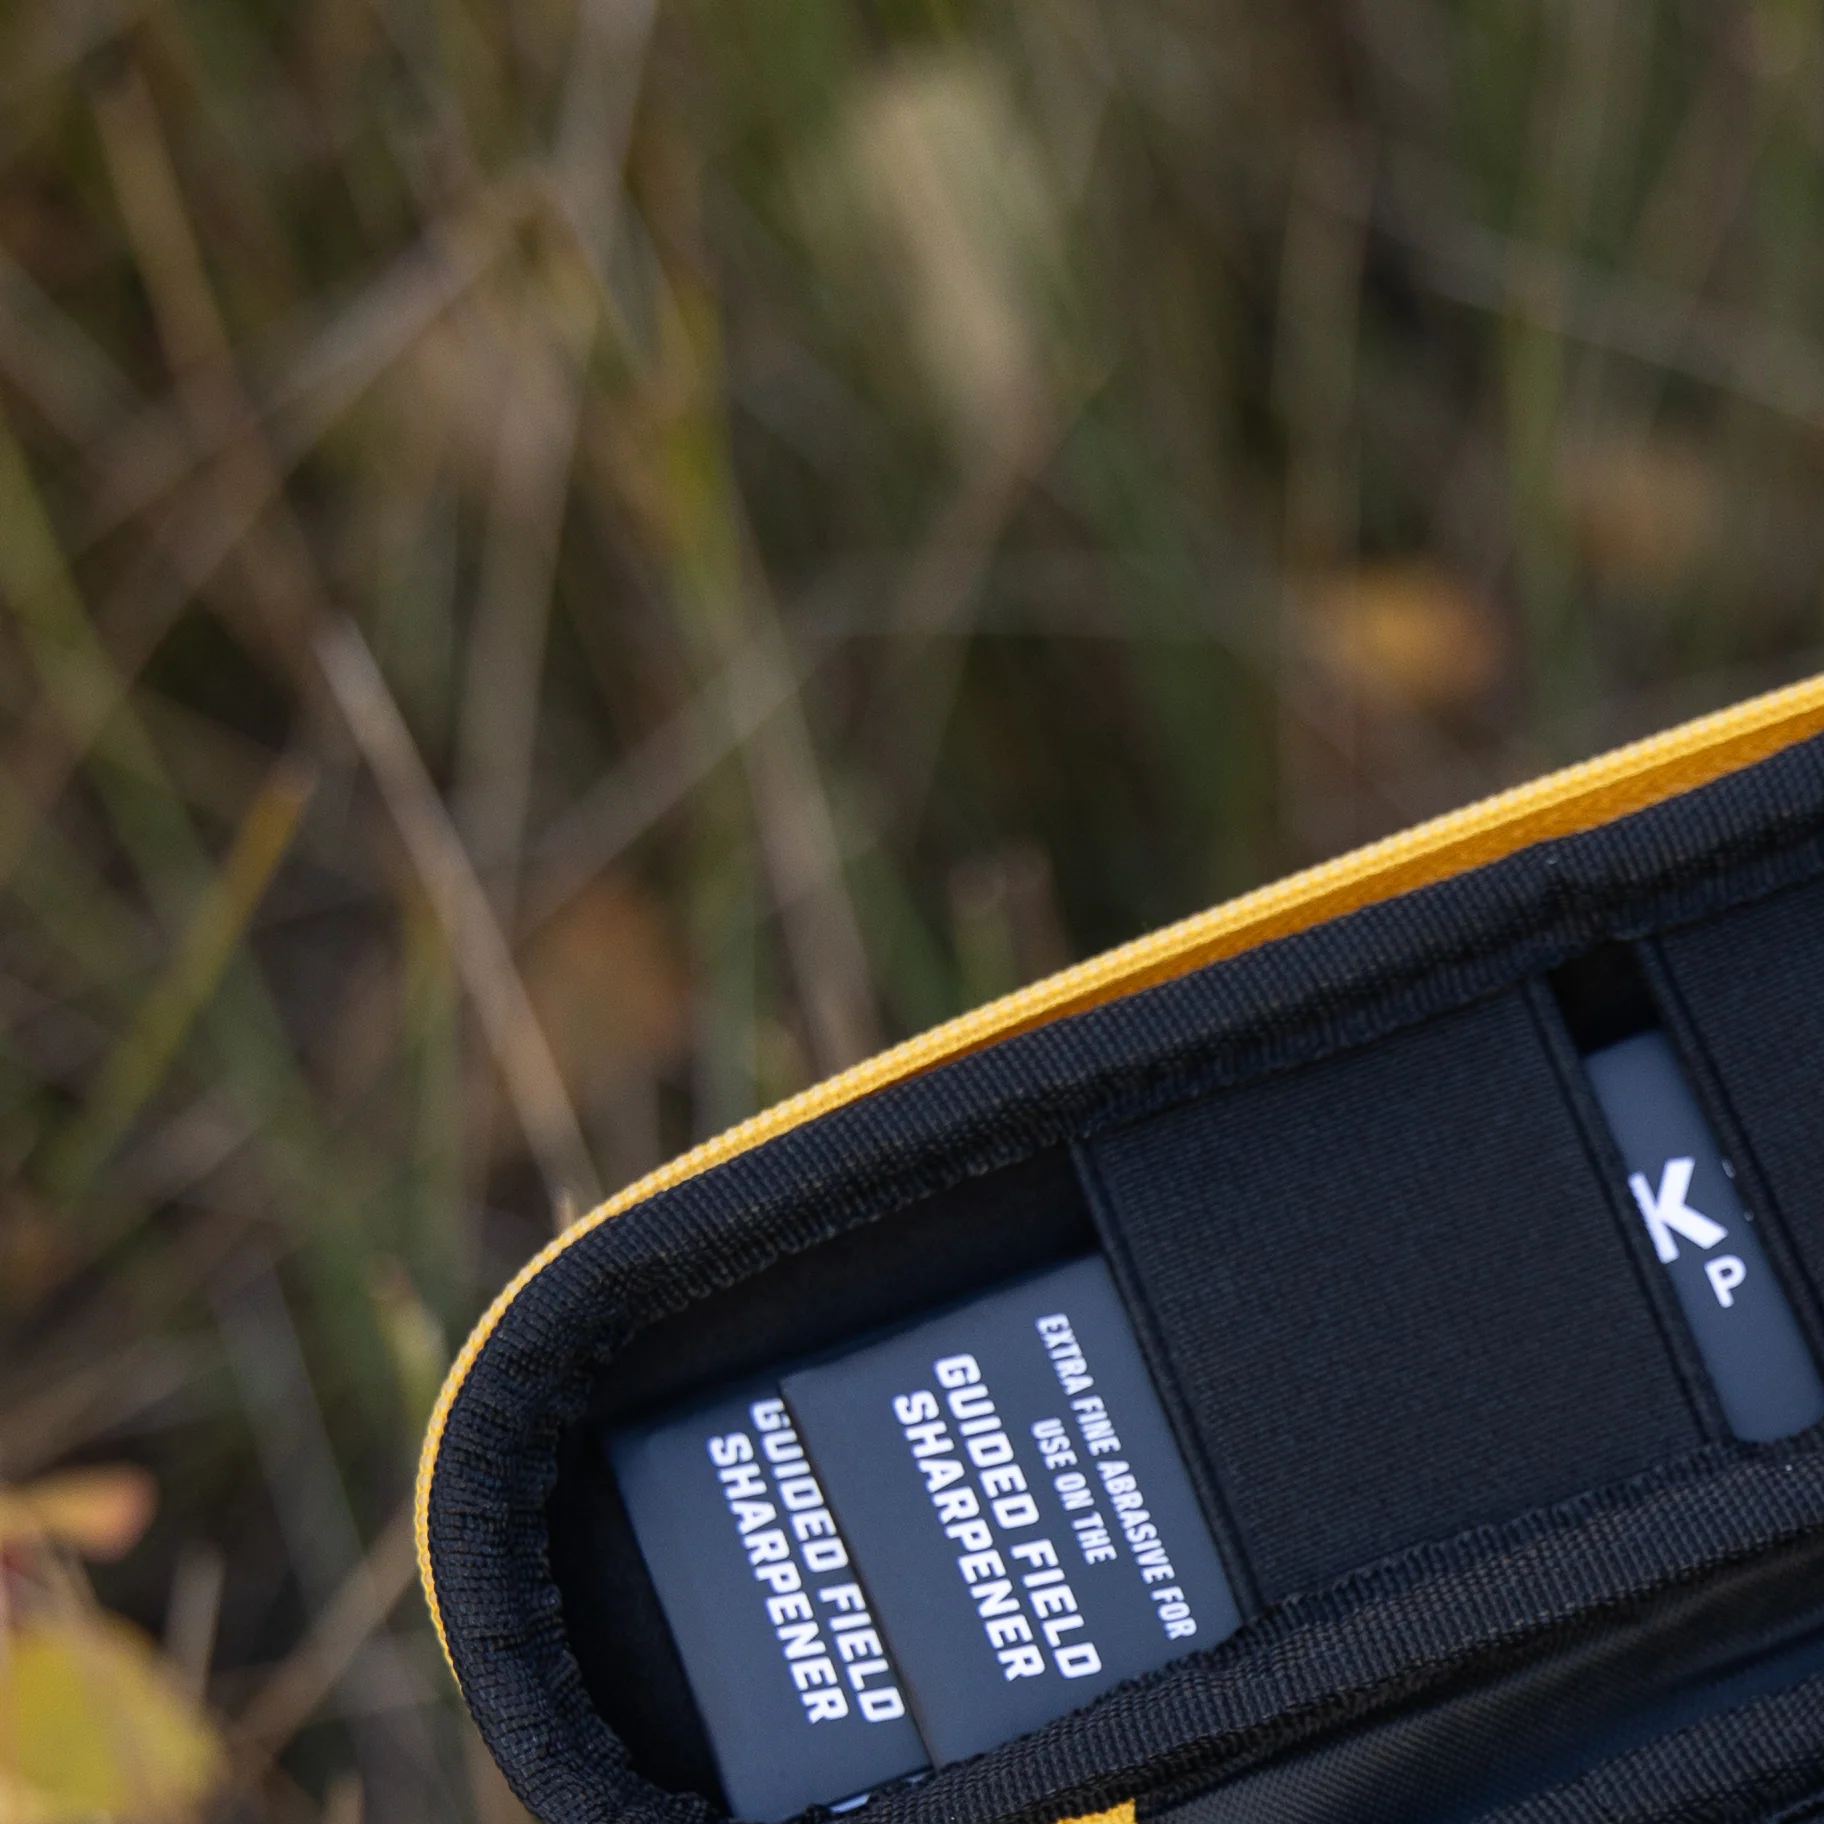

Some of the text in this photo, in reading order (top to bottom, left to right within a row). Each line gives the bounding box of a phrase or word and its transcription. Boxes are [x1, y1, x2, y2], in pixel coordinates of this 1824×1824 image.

[707, 1432, 849, 1724] SHARPENER
[750, 1397, 904, 1724] GUIDED FIELD
[893, 1388, 1045, 1682] SHARPENER
[934, 1353, 1101, 1680] GUIDED FIELD
[1032, 1418, 1117, 1565] USE ON THE
[1035, 1312, 1198, 1641] EXTRA FINE ABRASIVE FOR
